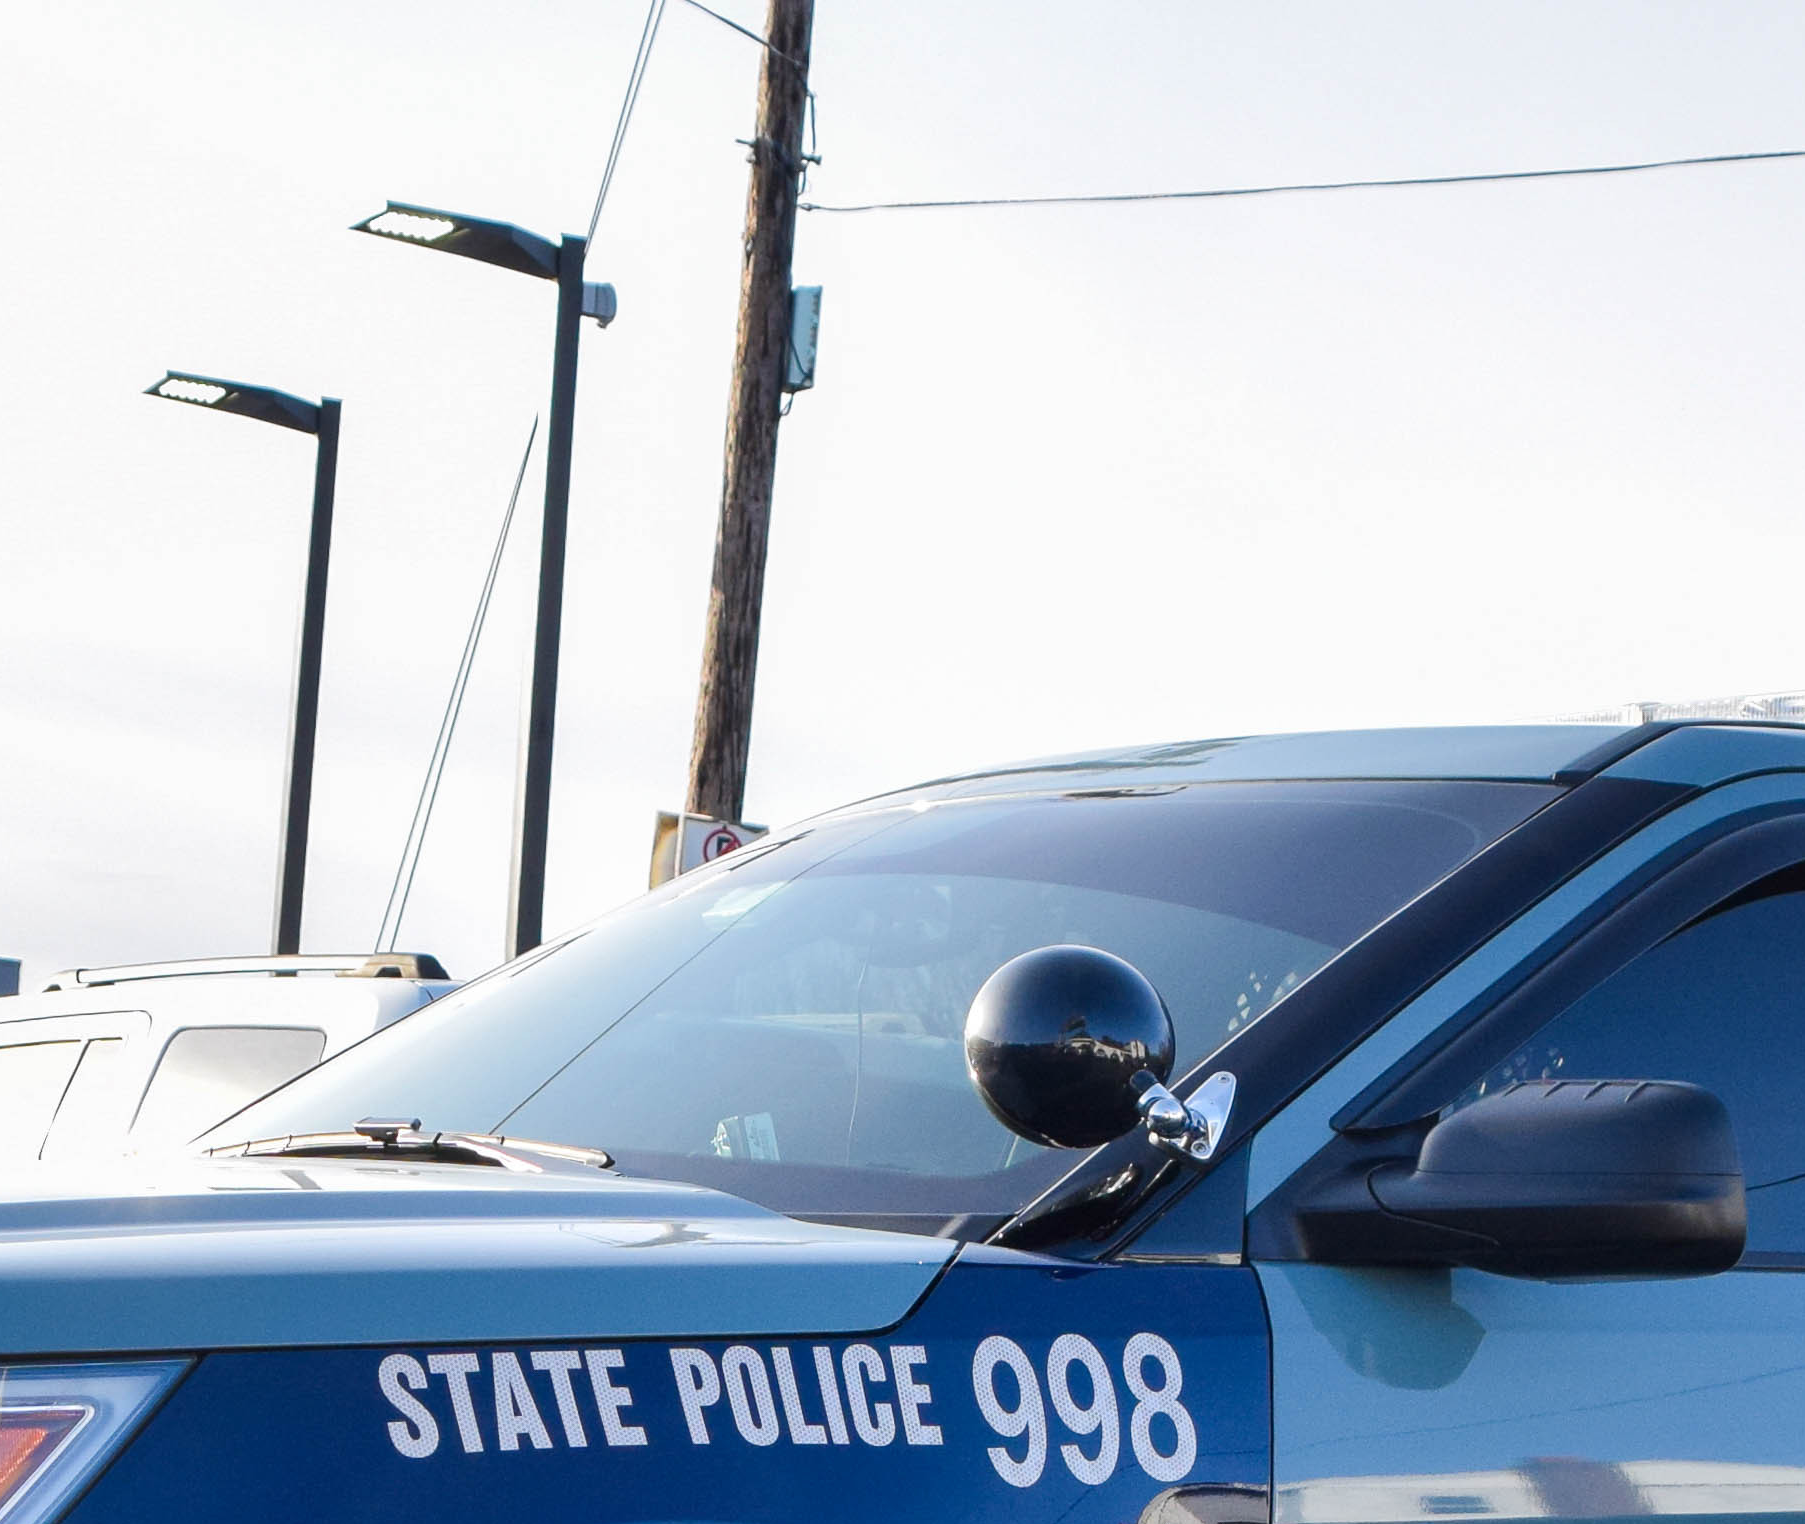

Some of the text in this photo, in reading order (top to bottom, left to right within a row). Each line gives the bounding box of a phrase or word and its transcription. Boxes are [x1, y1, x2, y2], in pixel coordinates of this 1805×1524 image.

[378, 1331, 1198, 1489] STATE POLICE 998
